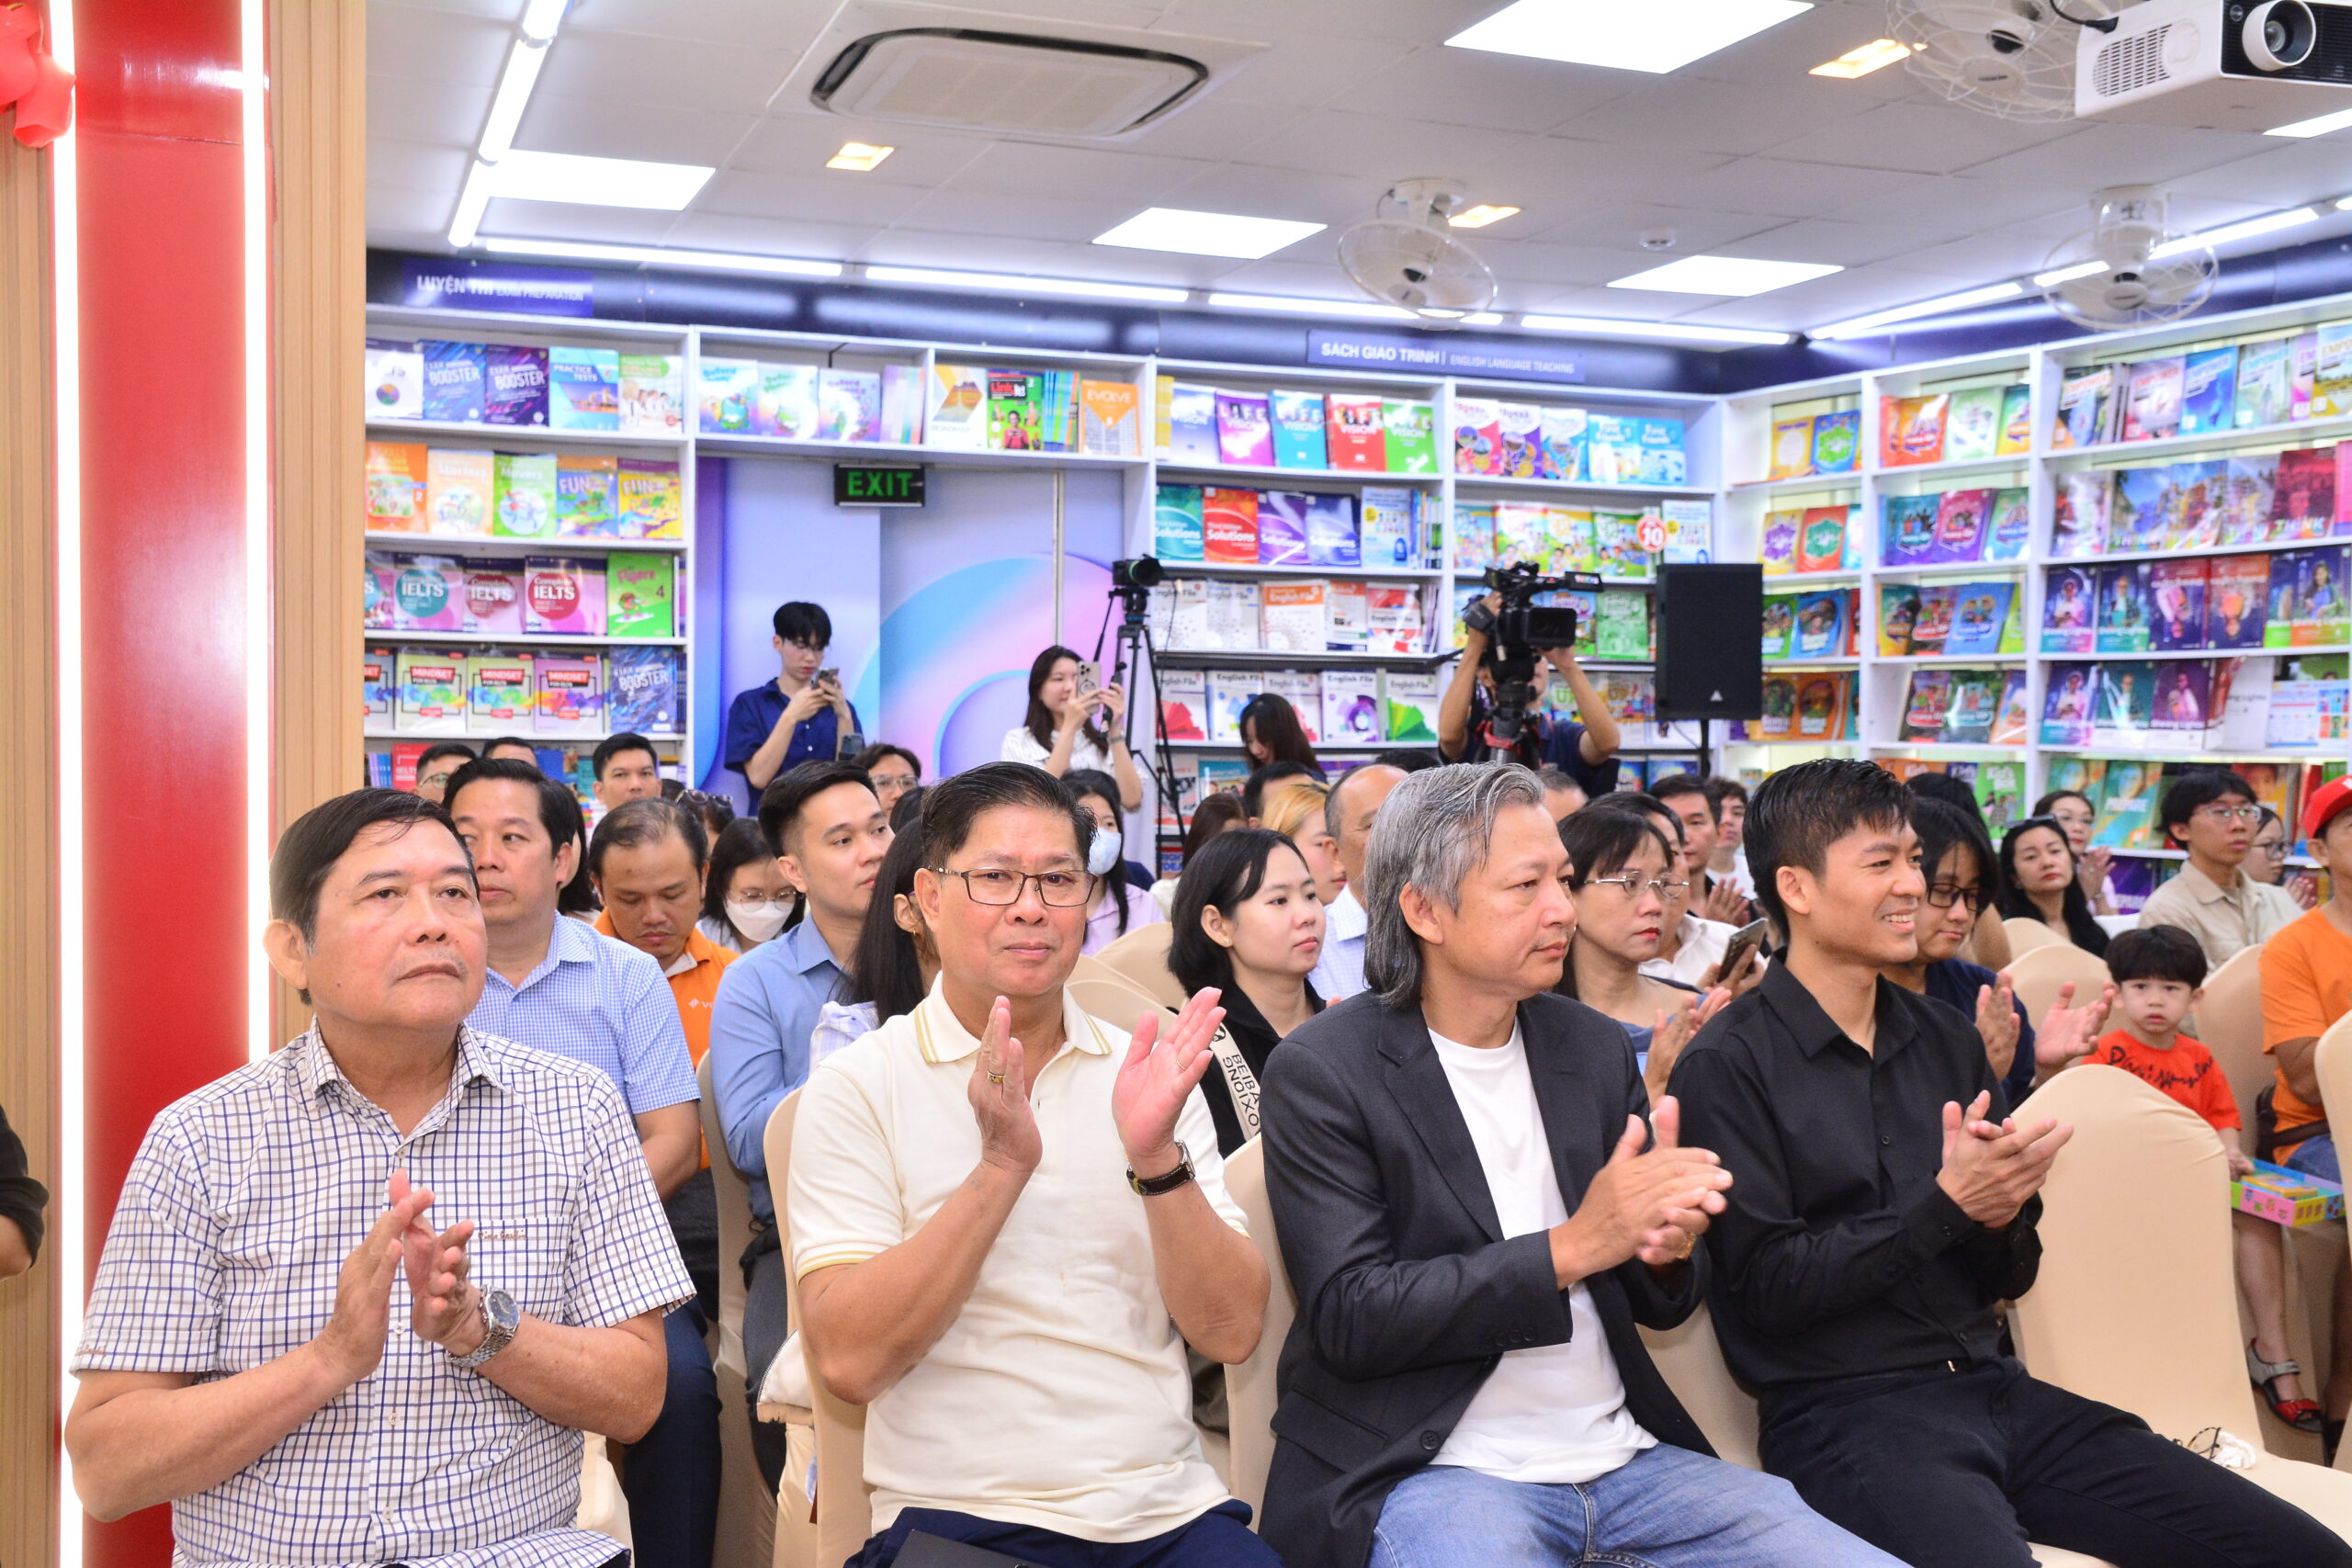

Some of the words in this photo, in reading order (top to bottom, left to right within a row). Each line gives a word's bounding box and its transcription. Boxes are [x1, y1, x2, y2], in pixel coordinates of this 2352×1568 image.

[416, 275, 466, 295] LUYỆN
[1450, 354, 1486, 367] ENGLISH
[1487, 357, 1532, 372] LANGUAGE
[1533, 359, 1575, 375] TEACHING
[429, 367, 481, 386] BOOSTER
[494, 370, 546, 390] BOOSTER
[1087, 389, 1132, 404] EVOLVE
[1340, 424, 1377, 435] VISION
[559, 476, 591, 494] FUN
[622, 479, 653, 496] FUN
[847, 471, 914, 497] EXIT
[1206, 529, 1256, 543] Solutions
[1642, 527, 1664, 547] 10
[401, 583, 445, 597] IELTS
[470, 587, 512, 602] IELTS
[534, 586, 575, 600] IELTS
[656, 585, 665, 598] 4
[1372, 615, 1396, 624] English
[413, 667, 454, 679] MINDSET
[481, 670, 524, 682] MINDSET
[548, 671, 589, 682] MINDSET
[1217, 673, 1248, 682] English
[1328, 675, 1357, 683] English
[617, 670, 669, 691] BOOSTER
[1390, 681, 1416, 690] English
